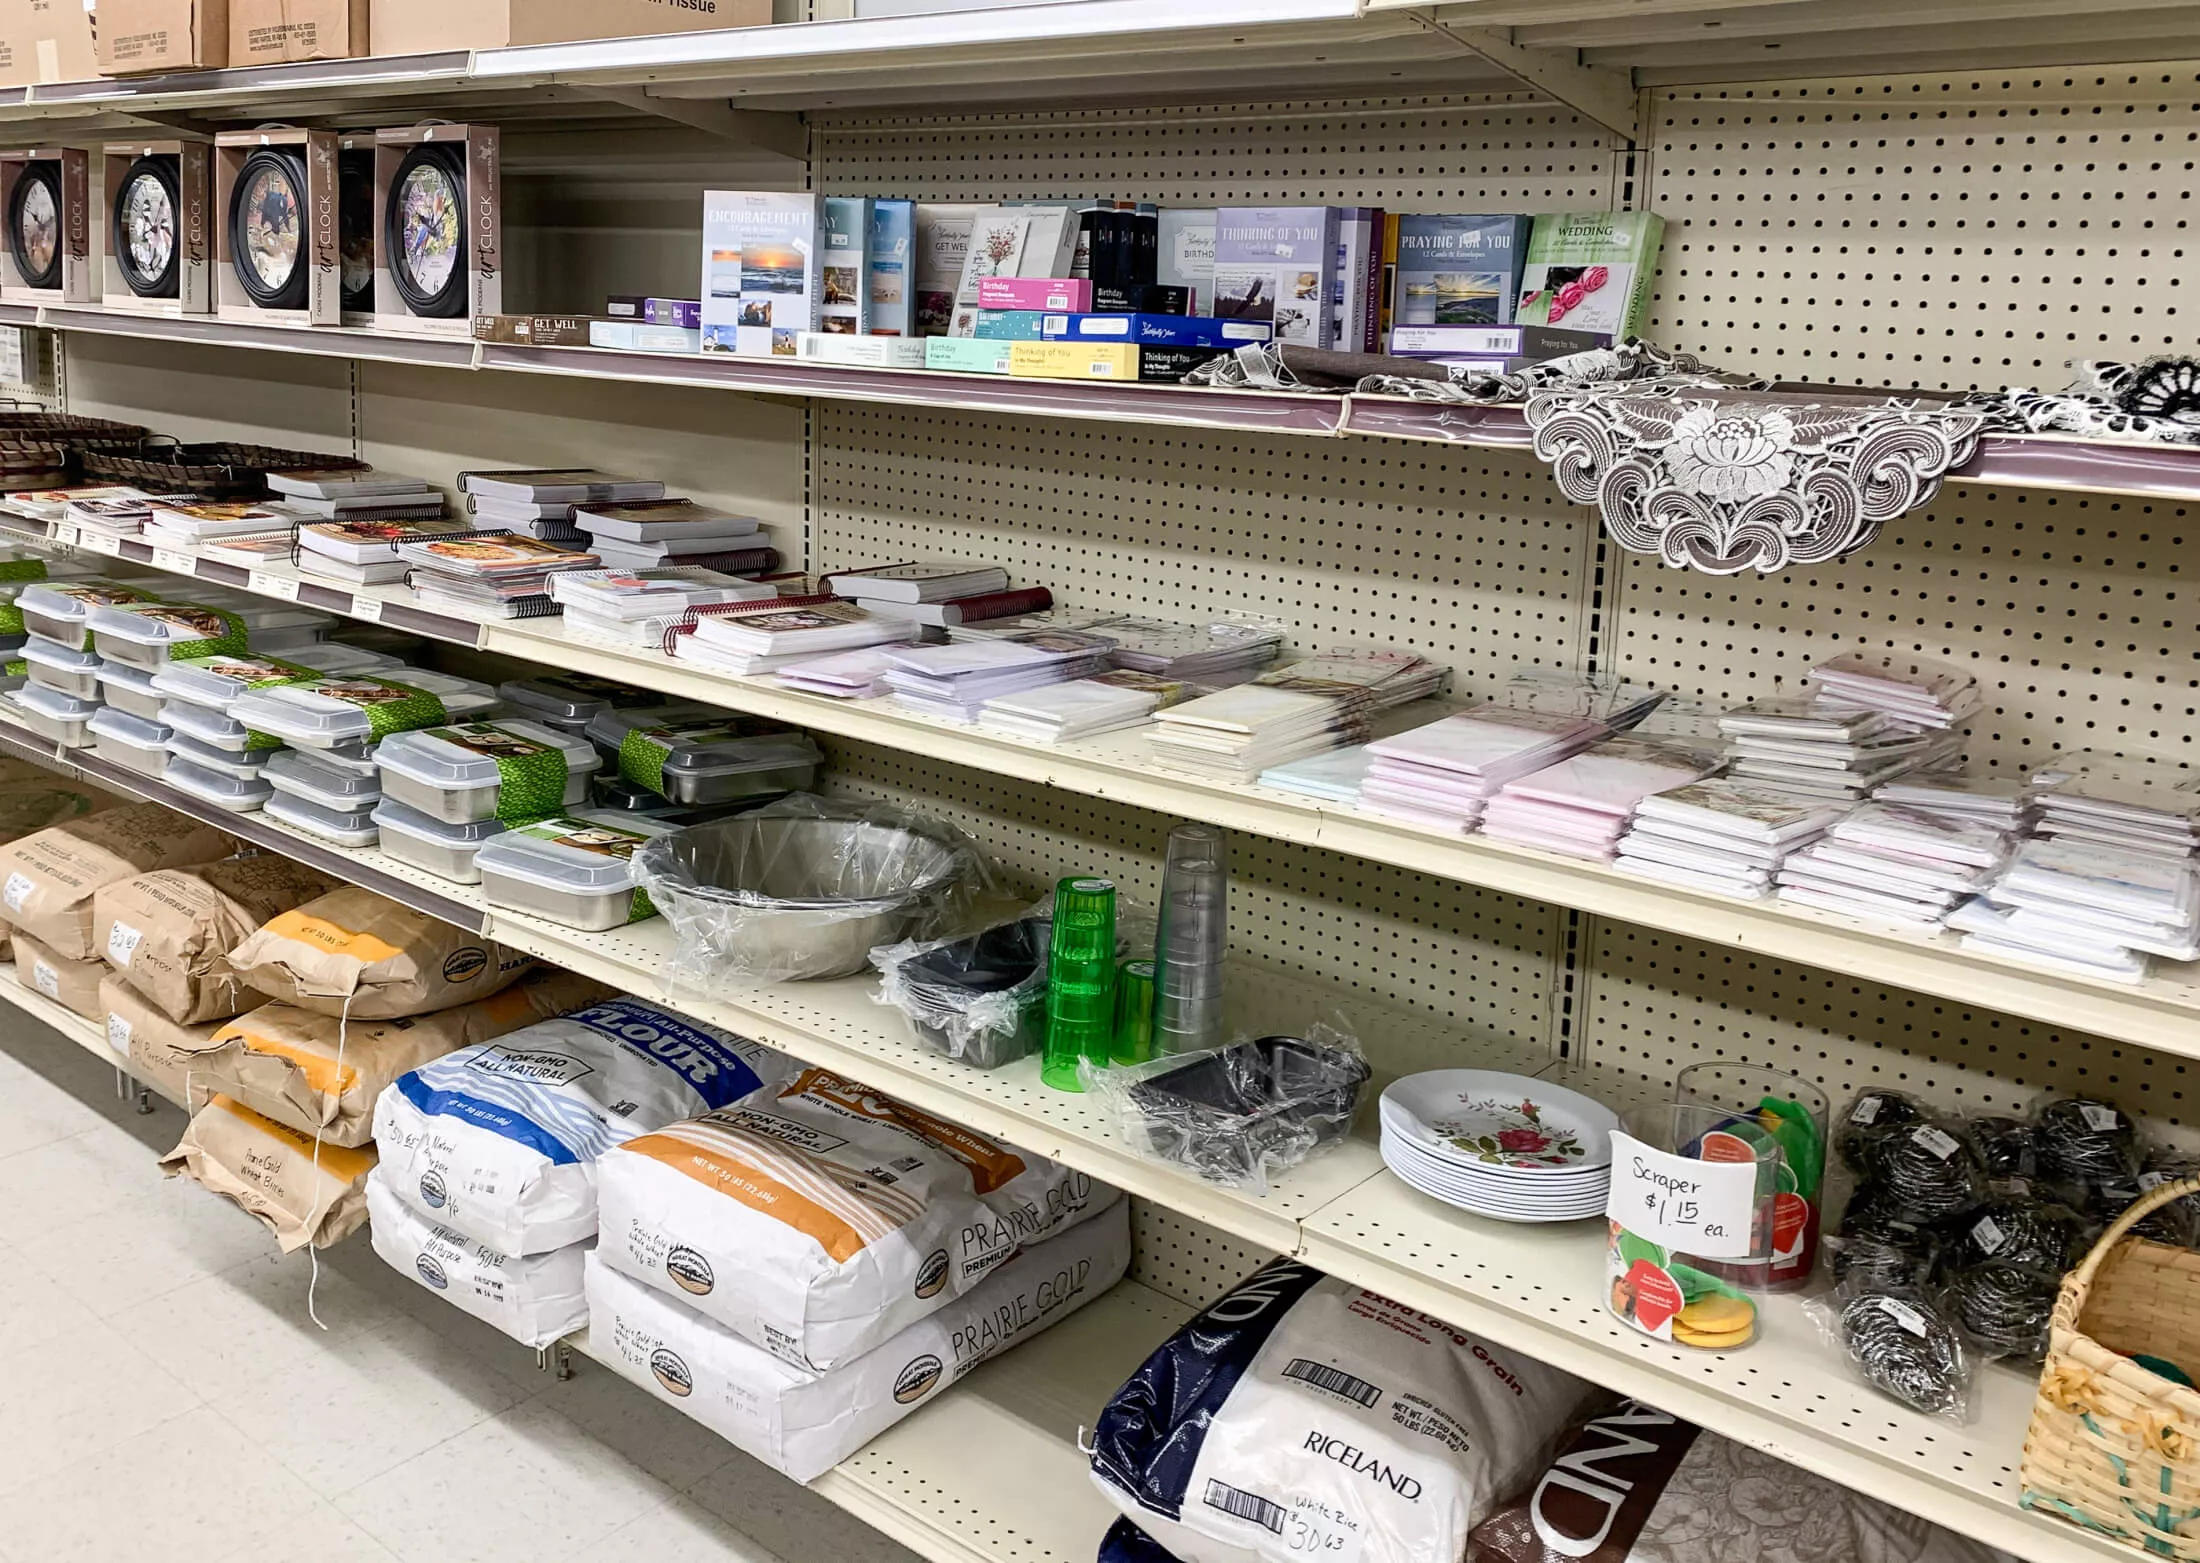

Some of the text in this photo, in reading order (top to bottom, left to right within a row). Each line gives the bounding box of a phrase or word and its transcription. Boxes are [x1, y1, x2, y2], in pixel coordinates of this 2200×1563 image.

[708, 209, 808, 226] ENCOURAGEMENT
[1222, 227, 1318, 241] THINKING OF YOU
[1401, 235, 1453, 249] PRAYING
[1487, 235, 1511, 248] YOU
[1558, 225, 1614, 237] WEDDING
[935, 242, 968, 251] GET WEL
[1184, 250, 1215, 259] BIRTHD
[982, 281, 1009, 292] Birthday
[1097, 287, 1123, 298] Birthday
[1627, 276, 1644, 330] WEDDING
[534, 318, 577, 330] GET WELL
[1367, 292, 1376, 346] THINKING
[1015, 347, 1046, 357] Thinking
[1541, 338, 1560, 349] Praying
[1144, 352, 1190, 364] Thinking of You
[567, 1007, 719, 1084] FLOUR
[475, 1060, 566, 1080] ALL NATURAL
[501, 1053, 568, 1068] NON-GMO
[799, 1093, 823, 1106] WHITE
[823, 1102, 850, 1117] WHOLE
[708, 1113, 823, 1149] ALL NATURAL
[737, 1110, 819, 1140] NON-GMO
[691, 1155, 706, 1168] NET
[706, 1163, 719, 1174] WT
[731, 1175, 745, 1187] LBS
[1632, 1155, 1702, 1203] Scraper
[961, 1172, 1091, 1257] PRAIRIE GOLD
[1704, 1223, 1729, 1238] ea.
[952, 1294, 1028, 1361] PRAIRIE
[1036, 1259, 1091, 1309] GOLD
[1379, 1309, 1391, 1318] de
[1393, 1314, 1423, 1333] Grano
[1348, 1304, 1432, 1345] Largo Enriquecido
[1360, 1288, 1524, 1396] Extra Long Grain
[1392, 1412, 1405, 1424] 50
[1404, 1418, 1421, 1431] LBS
[1392, 1401, 1409, 1414] NET
[1428, 1417, 1450, 1434] PESO
[1449, 1431, 1470, 1452] NETO
[1303, 1430, 1423, 1501] RICELAND
[1295, 1495, 1359, 1532] White Rice
